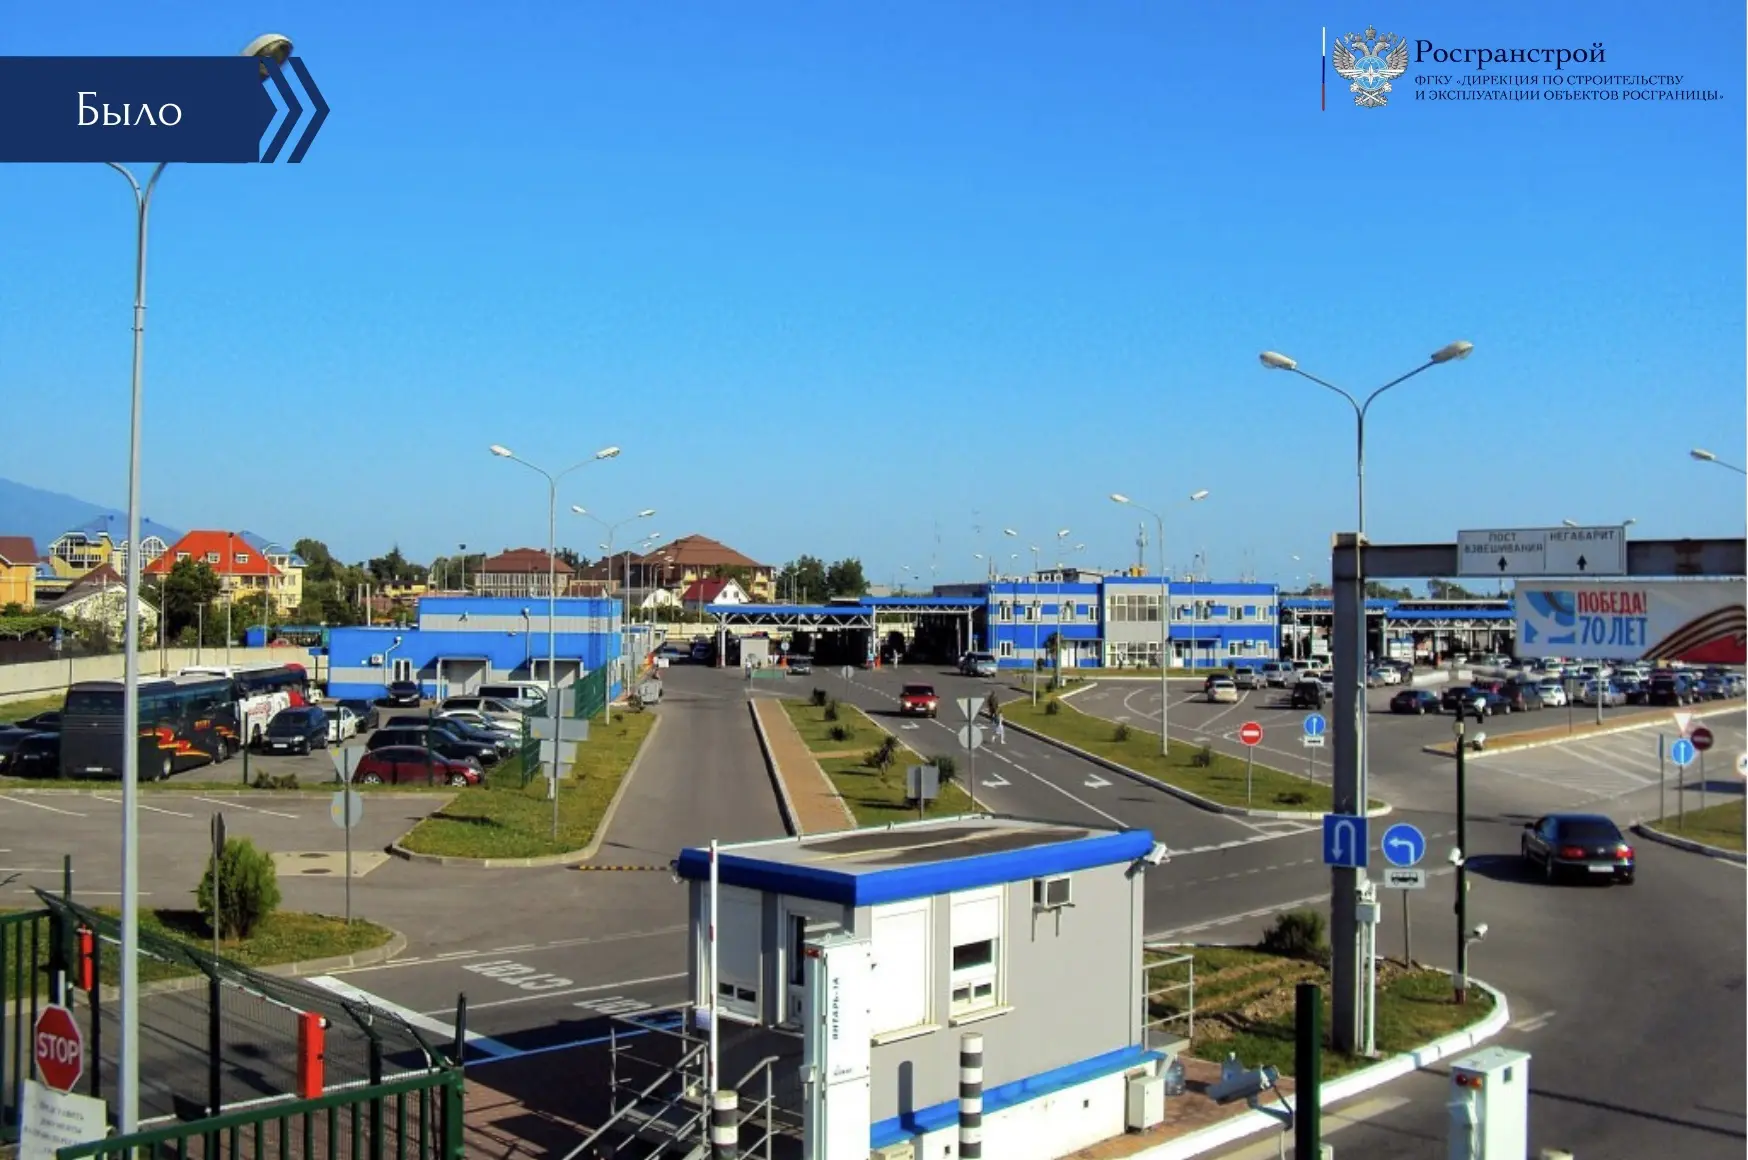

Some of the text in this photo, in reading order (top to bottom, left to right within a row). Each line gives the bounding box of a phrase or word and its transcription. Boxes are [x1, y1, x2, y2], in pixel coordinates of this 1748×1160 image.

[1488, 532, 1516, 542] ПОСТ
[1550, 530, 1614, 541] НЕГАБАРИТ
[1577, 591, 1647, 614] ПОБЕДА!
[1579, 616, 1648, 645] 70 ЛЕТ
[38, 1032, 79, 1065] STOP
